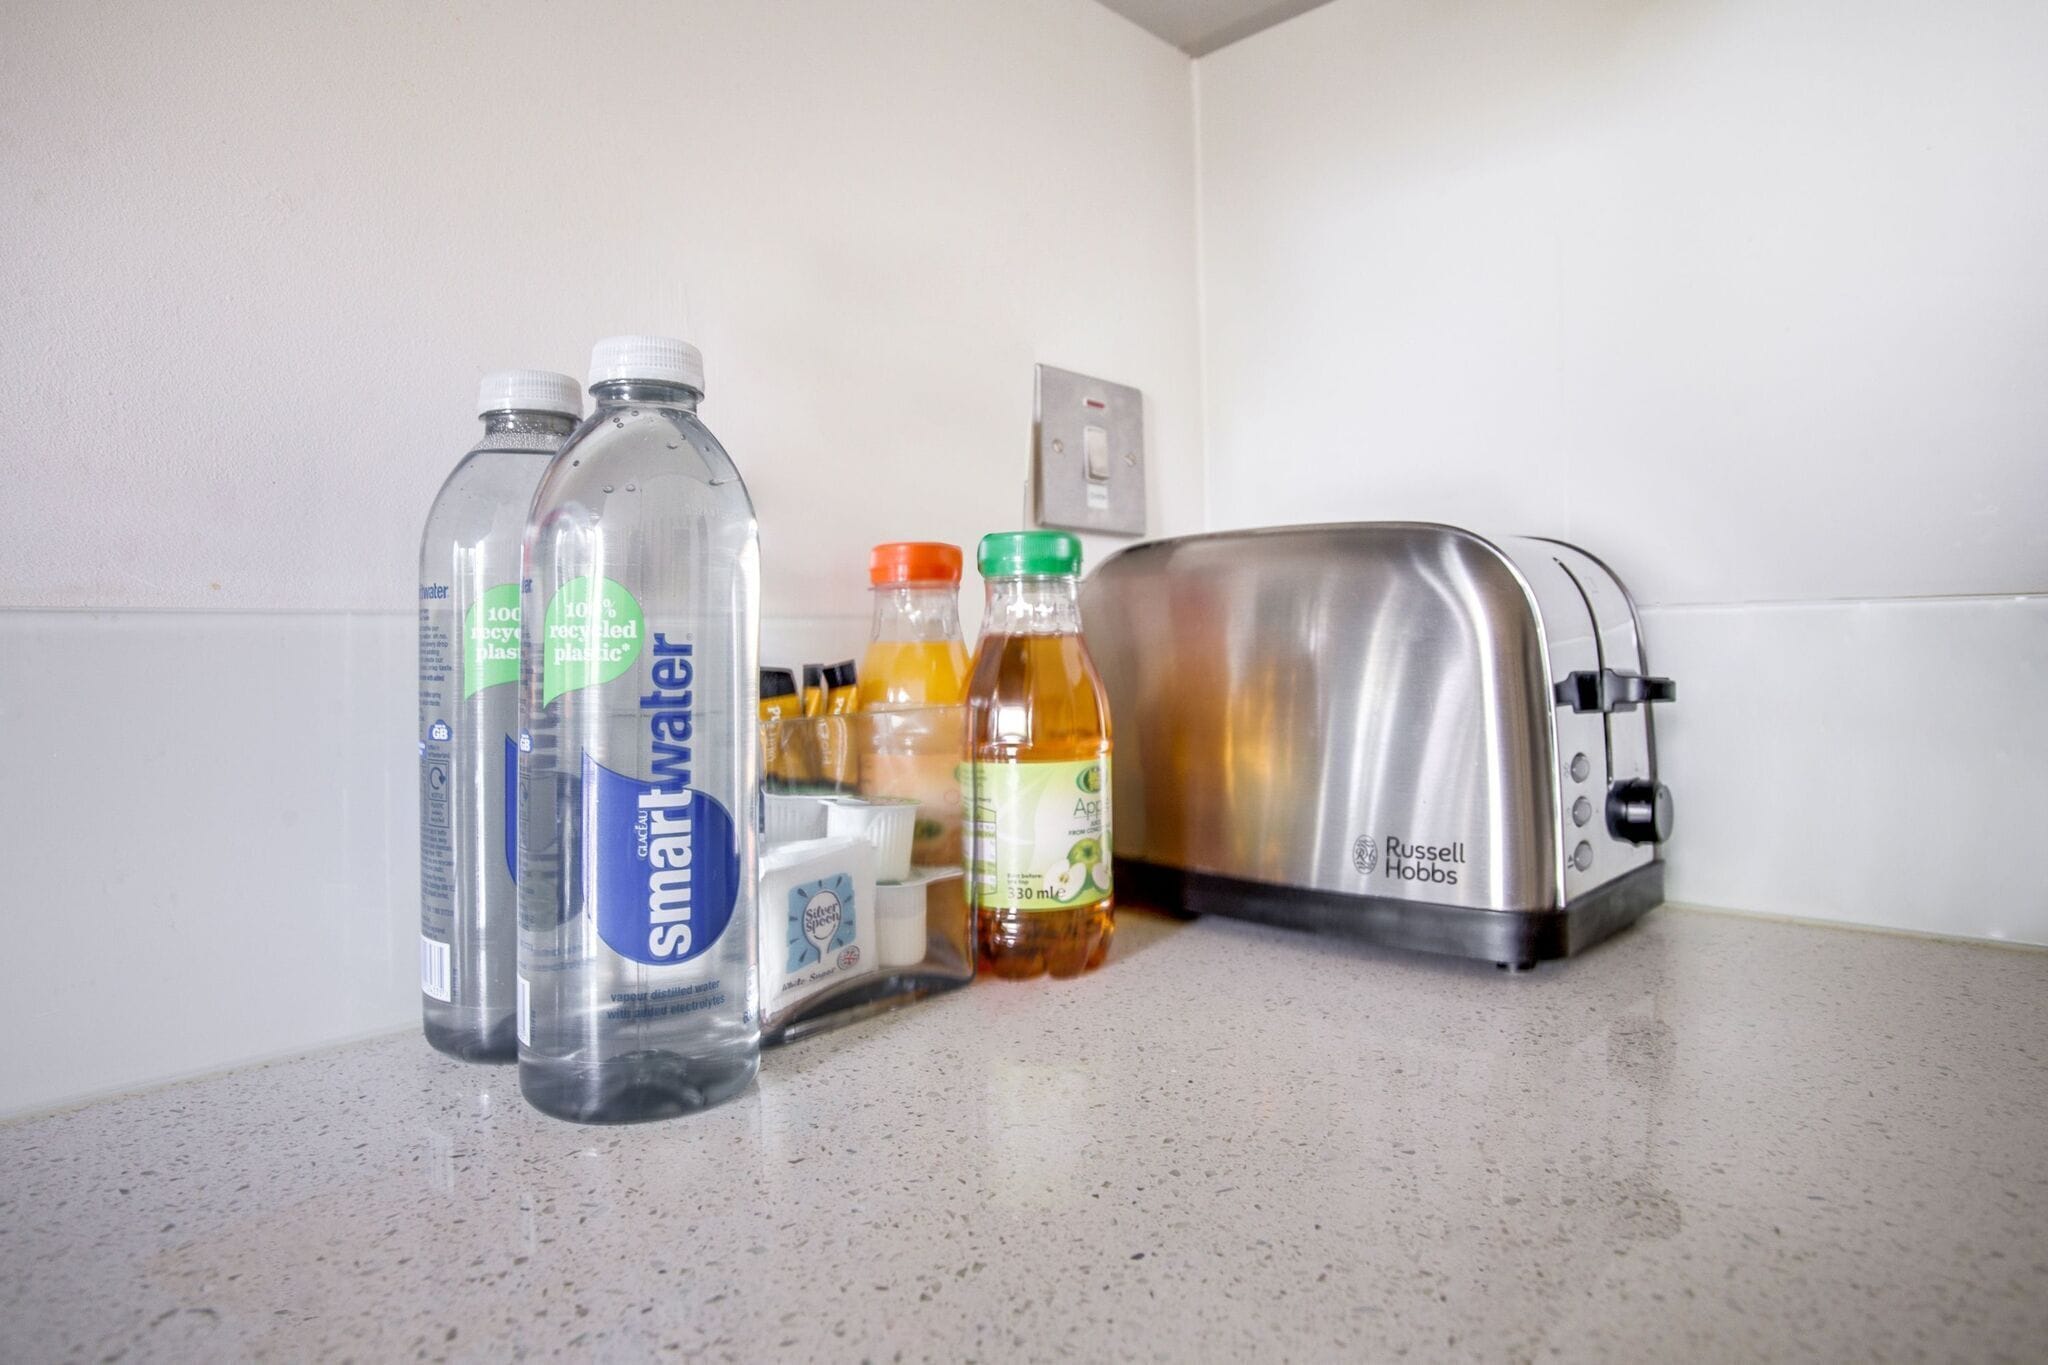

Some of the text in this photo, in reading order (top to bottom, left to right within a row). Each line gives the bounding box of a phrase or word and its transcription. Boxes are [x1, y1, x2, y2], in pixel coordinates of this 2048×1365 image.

[565, 598, 616, 619] 10%
[553, 643, 631, 665] plasic
[432, 727, 448, 740] GB
[1386, 836, 1466, 863] Russell
[1385, 858, 1458, 885] Hobbs
[1008, 886, 1033, 900] 330
[806, 902, 839, 921] Silver
[651, 984, 693, 1000] distilled
[695, 979, 720, 993] water
[670, 994, 726, 1015] electrolytes
